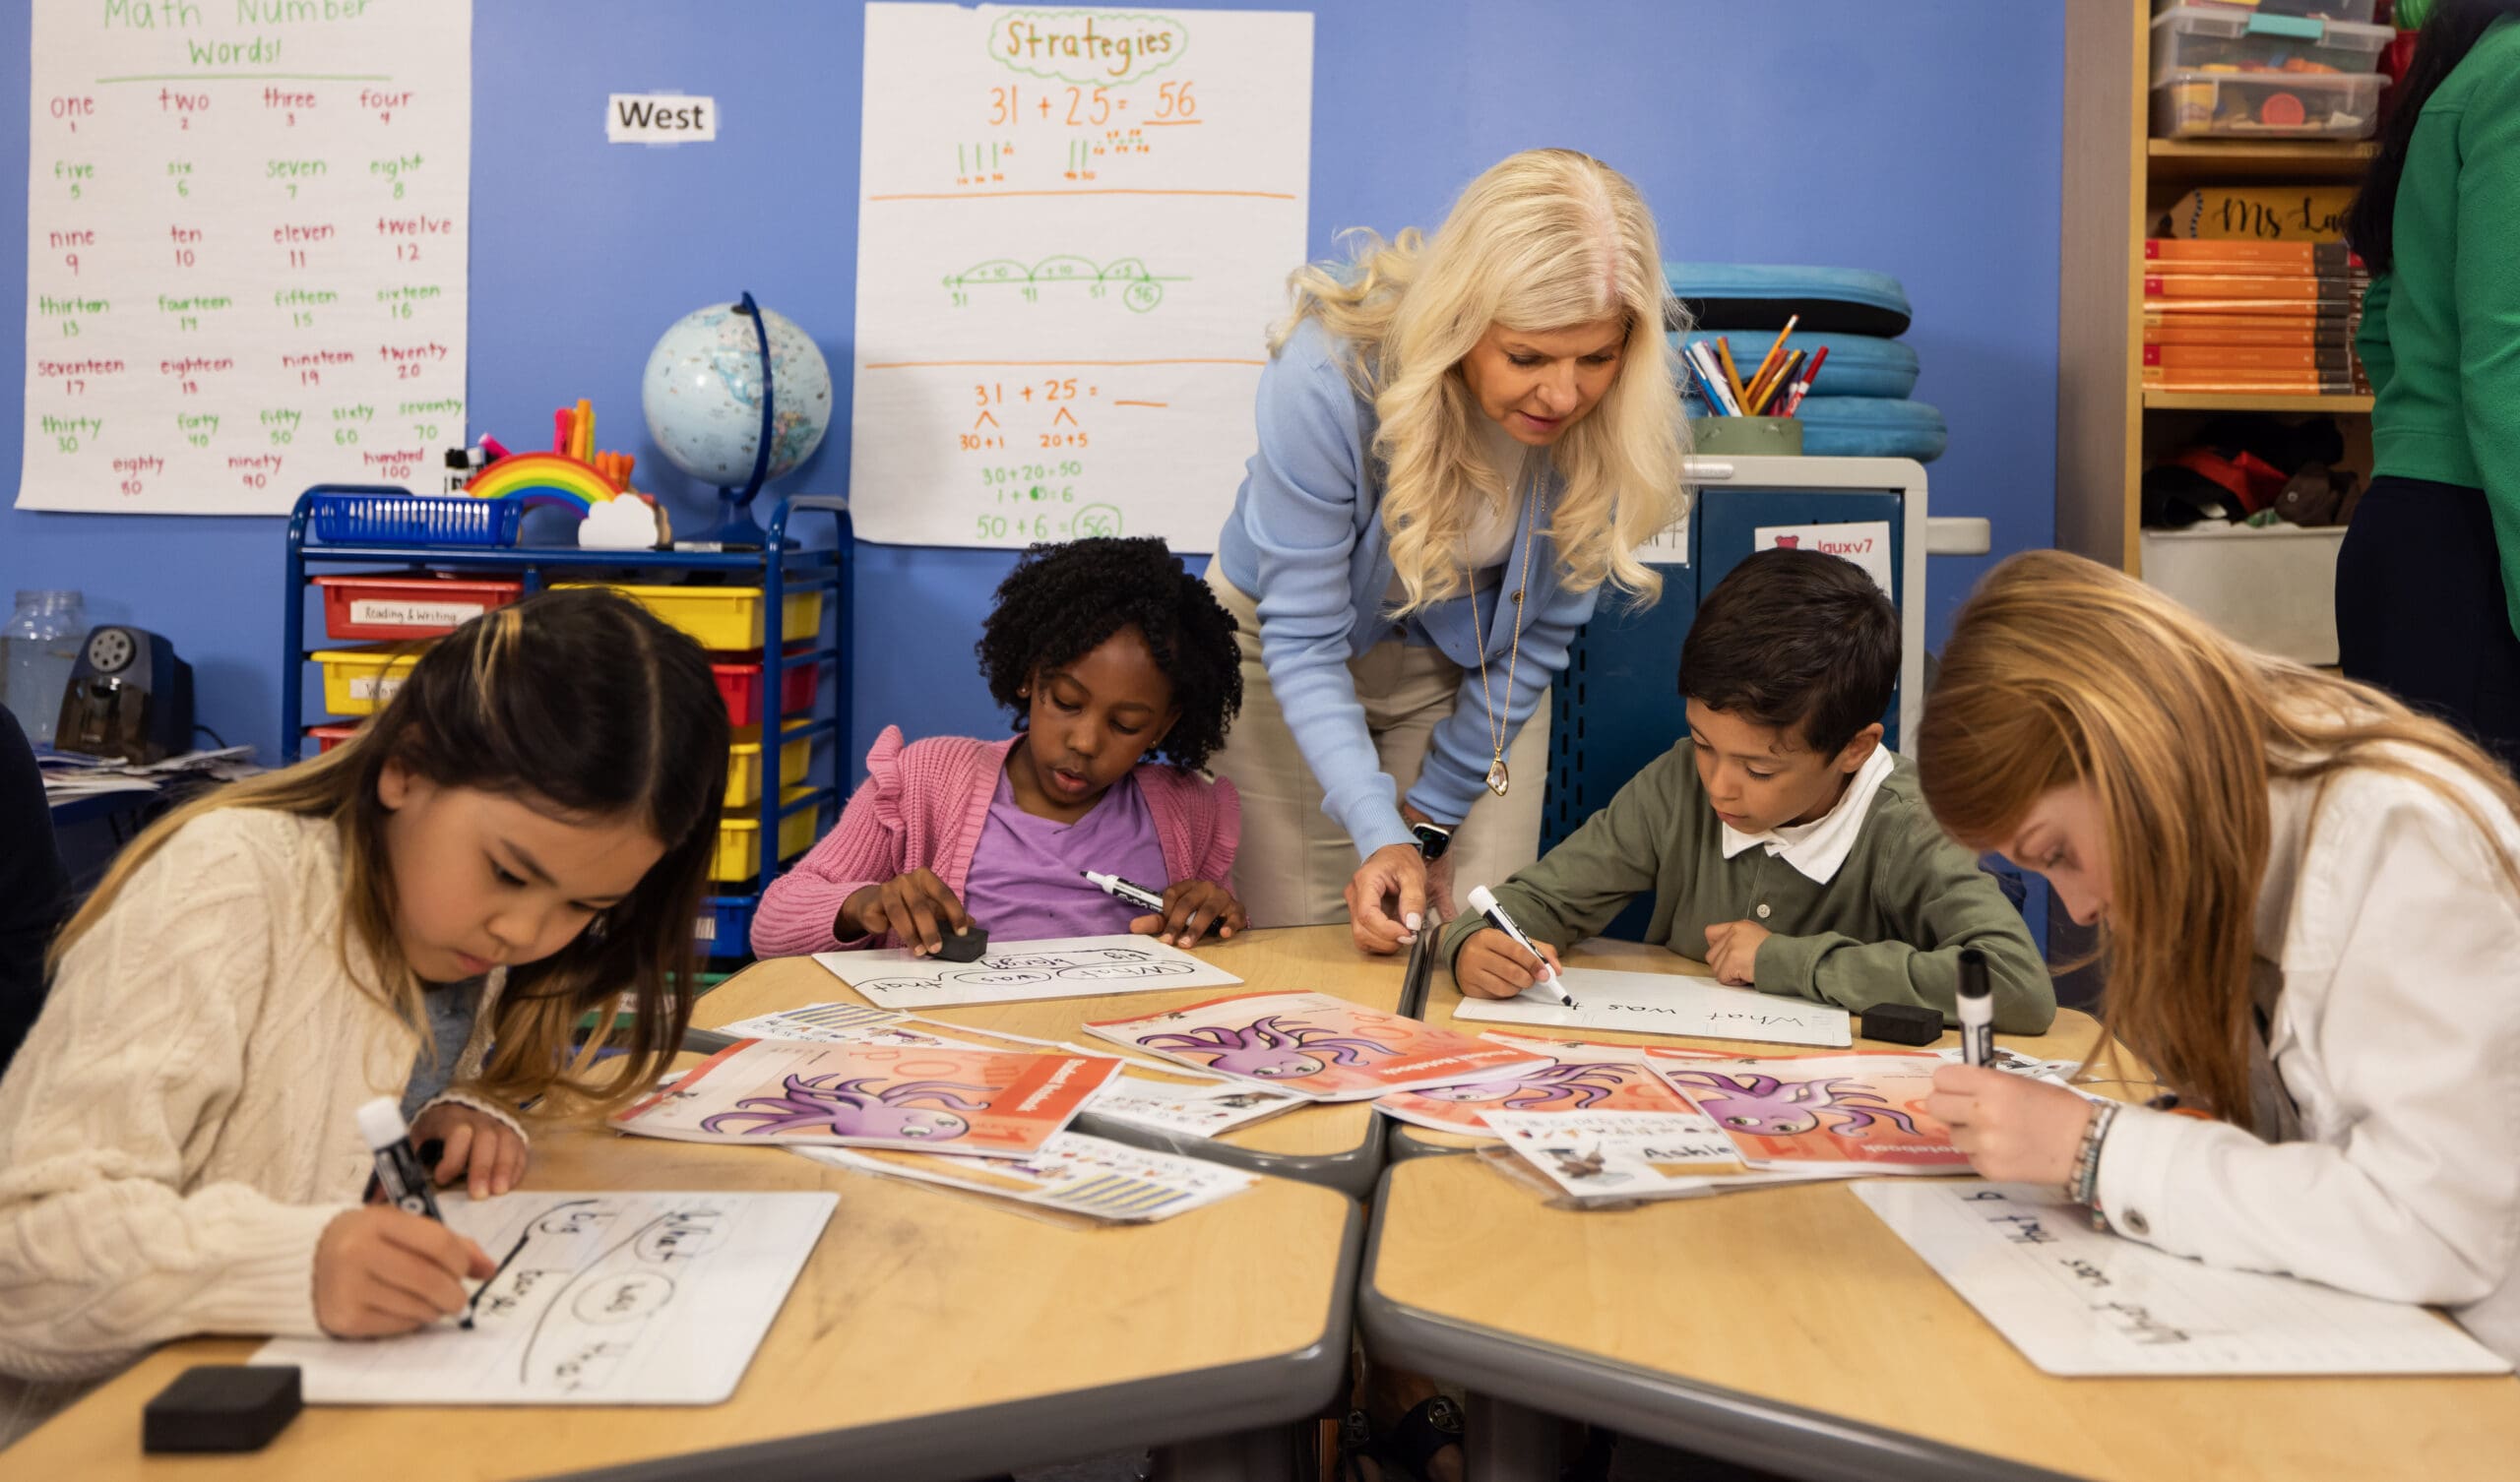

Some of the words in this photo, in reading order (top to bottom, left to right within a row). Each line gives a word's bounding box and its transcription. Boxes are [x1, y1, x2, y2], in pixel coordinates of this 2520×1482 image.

[103, 0, 202, 31] Math
[235, 0, 372, 28] Number
[188, 36, 282, 65] Words!
[1005, 16, 1173, 76] Strategies
[50, 96, 94, 118] one
[158, 88, 210, 111] two
[263, 87, 315, 108] three
[359, 91, 411, 108] four
[618, 100, 704, 130] West
[989, 85, 1018, 126] 31
[1064, 84, 1113, 128] 25
[1152, 79, 1199, 119] 56
[181, 116, 189, 131] 2
[287, 112, 295, 127] 3
[380, 110, 391, 125] 4
[54, 160, 94, 180] five
[167, 161, 193, 175] six
[267, 160, 327, 178] seven
[369, 153, 424, 186] eight
[70, 183, 81, 199] 5
[176, 180, 189, 197] 6
[285, 183, 298, 199] 7
[393, 181, 405, 200] 8
[49, 229, 94, 248] nine
[170, 225, 202, 243] ten
[273, 223, 335, 243] eleven
[377, 215, 452, 235] twelve
[2212, 197, 2281, 239] Ms
[65, 253, 79, 275] 9
[175, 248, 196, 268] 10
[289, 249, 306, 269] 11
[397, 243, 420, 262] 12
[158, 295, 232, 312] fourteen
[274, 289, 338, 306] fifteen
[377, 284, 441, 302] sixteen
[62, 319, 80, 338] 13
[180, 316, 198, 332] 14
[292, 311, 313, 329] 15
[391, 301, 413, 320] 16
[37, 358, 125, 377] seventeen
[159, 356, 233, 377] eighteen
[282, 349, 354, 368] nineteen
[380, 341, 447, 361] twenty
[66, 379, 86, 395] 17
[182, 380, 198, 395] 18
[300, 369, 320, 385] 19
[397, 362, 420, 379] 20
[976, 383, 1002, 407] 31
[1044, 378, 1078, 401] 25
[41, 415, 102, 439] thirty
[260, 408, 302, 430] fifty
[332, 403, 375, 422] sixty
[399, 398, 464, 416] seventy
[57, 434, 81, 454] 30
[188, 433, 210, 448] 40
[270, 429, 292, 445] 50
[334, 428, 358, 446] 60
[413, 424, 438, 441] 70
[112, 455, 164, 478] eighty
[227, 454, 283, 476] ninety
[362, 447, 424, 465] hundred
[120, 480, 143, 495] 80
[242, 473, 267, 489] 90
[378, 462, 411, 479] 100
[1061, 486, 1074, 503] 6
[976, 514, 1007, 539] 50
[1034, 513, 1048, 539] 6
[1082, 515, 1112, 537] 56
[364, 606, 404, 624] Reading
[1076, 964, 1180, 978] What
[1103, 952, 1147, 962] big
[873, 979, 942, 993] that
[980, 973, 1034, 985] was
[1607, 1004, 1676, 1016] was
[1705, 1012, 1803, 1027] What
[1379, 1058, 1453, 1076] Notebook
[1449, 1049, 1518, 1065] Student
